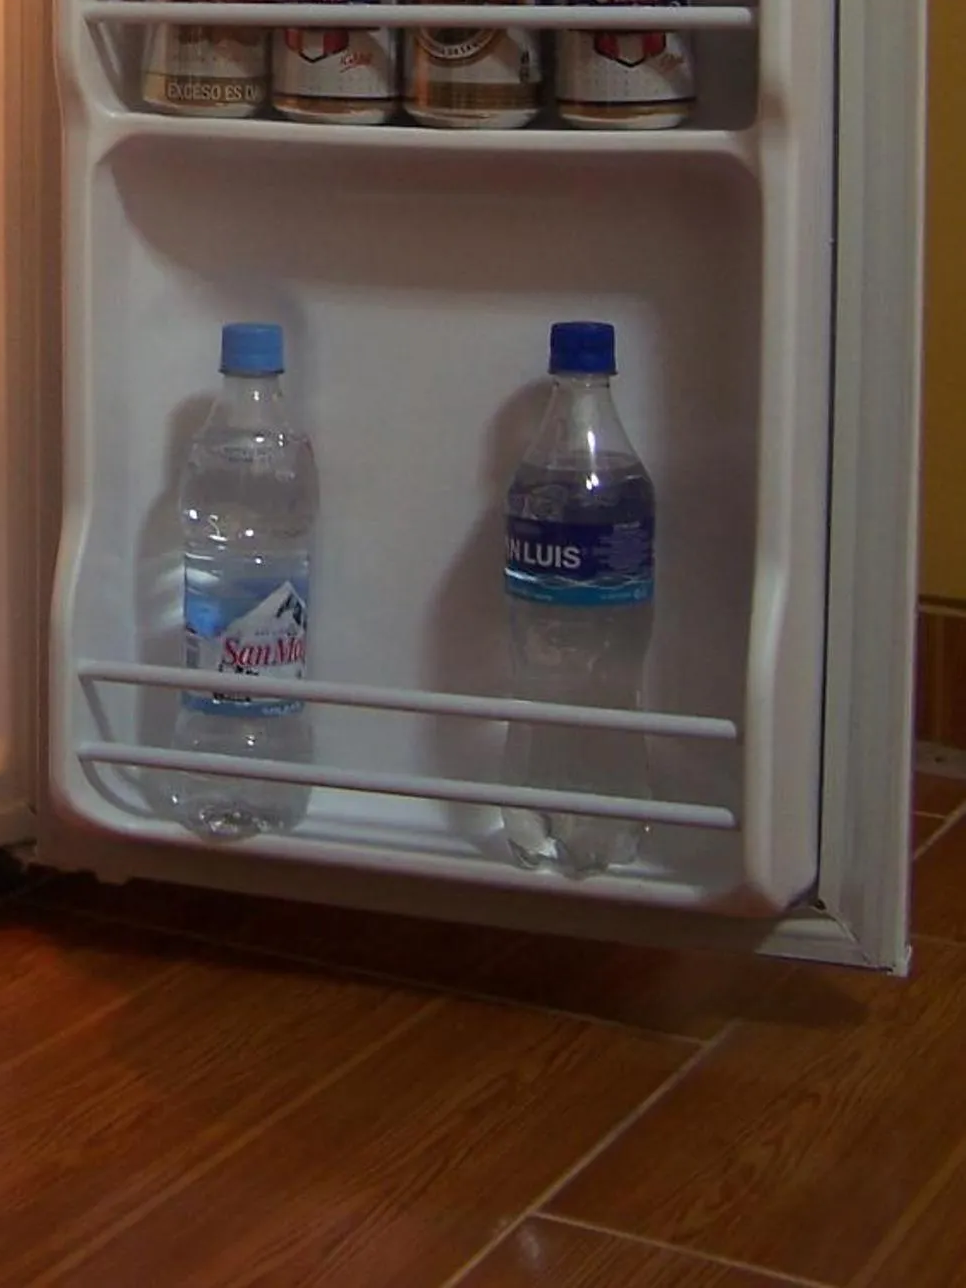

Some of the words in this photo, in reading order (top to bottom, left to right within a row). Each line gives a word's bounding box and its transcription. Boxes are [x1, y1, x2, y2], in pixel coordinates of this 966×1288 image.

[167, 82, 222, 100] EXCESO
[225, 84, 242, 100] ES
[523, 541, 582, 569] LUIS
[221, 636, 271, 668] San
